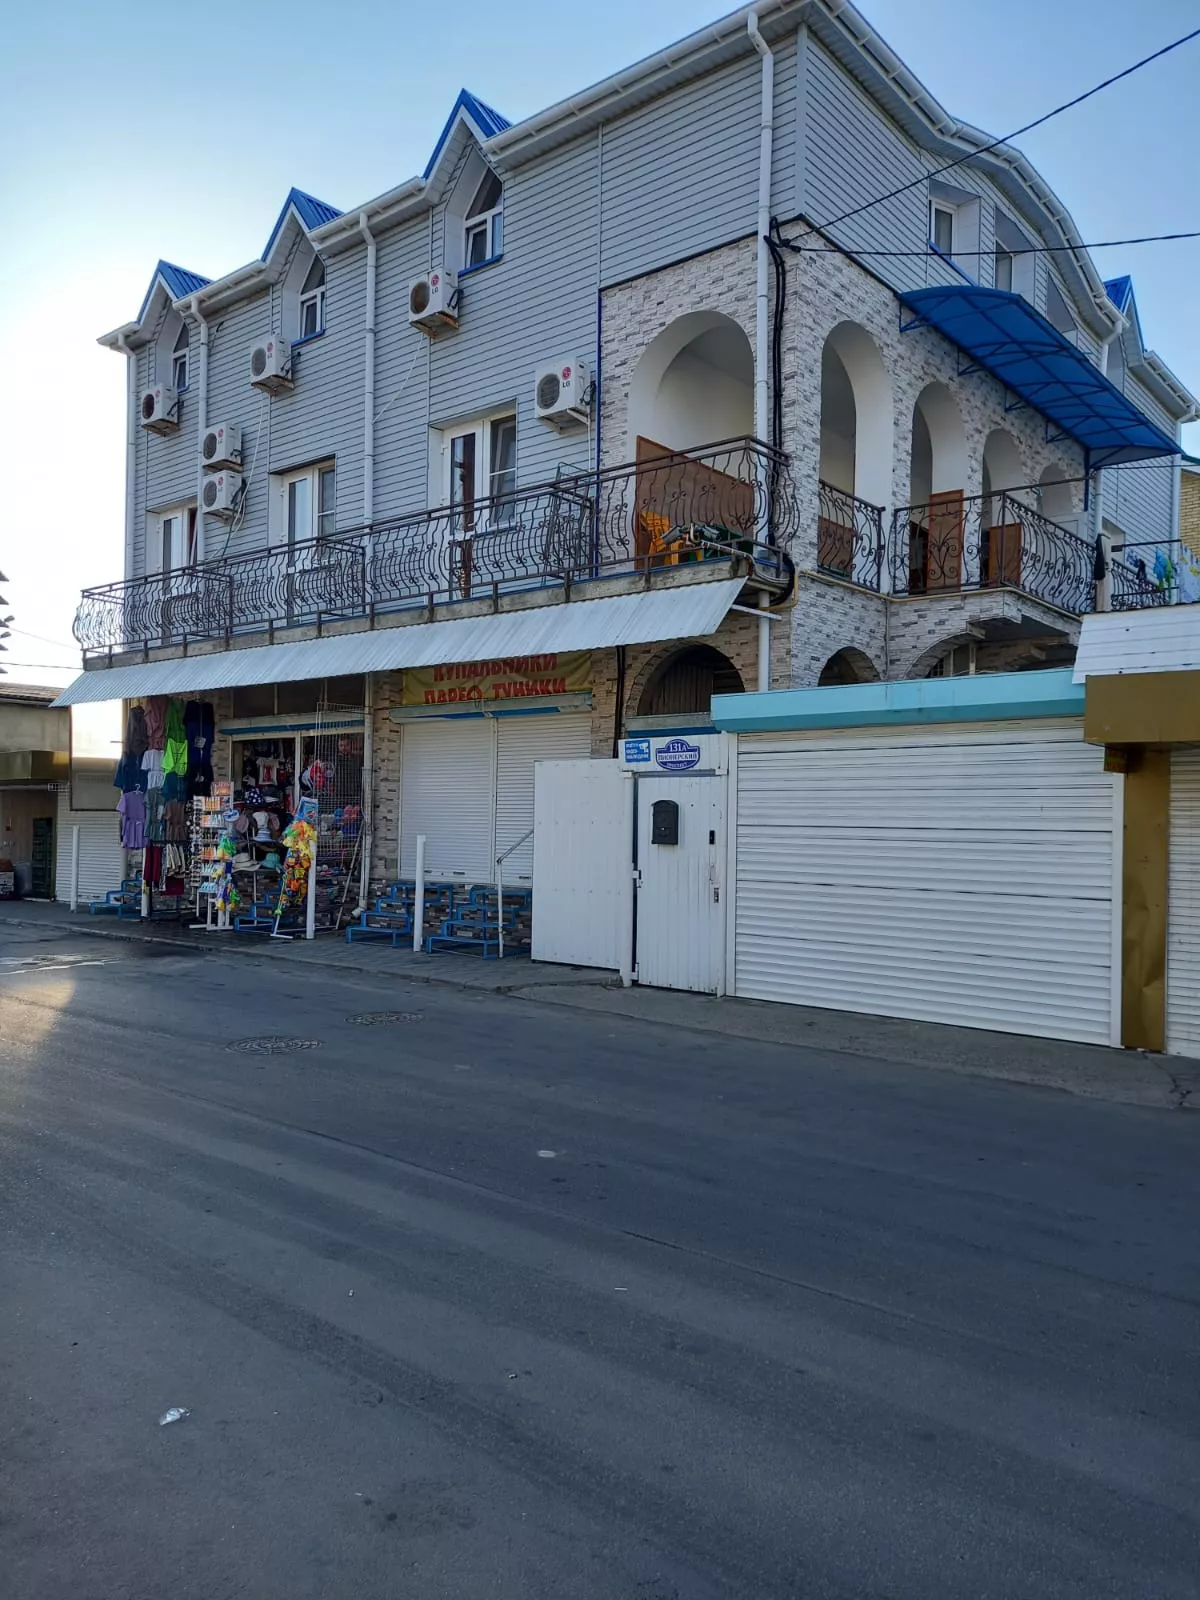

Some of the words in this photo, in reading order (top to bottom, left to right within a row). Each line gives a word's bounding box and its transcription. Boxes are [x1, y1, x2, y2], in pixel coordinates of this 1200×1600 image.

[433, 654, 558, 682] КУПАЛЬНИКИ
[424, 684, 484, 704] ПАРЕО
[492, 677, 567, 699] ТУНИКИ
[670, 743, 687, 752] 131А
